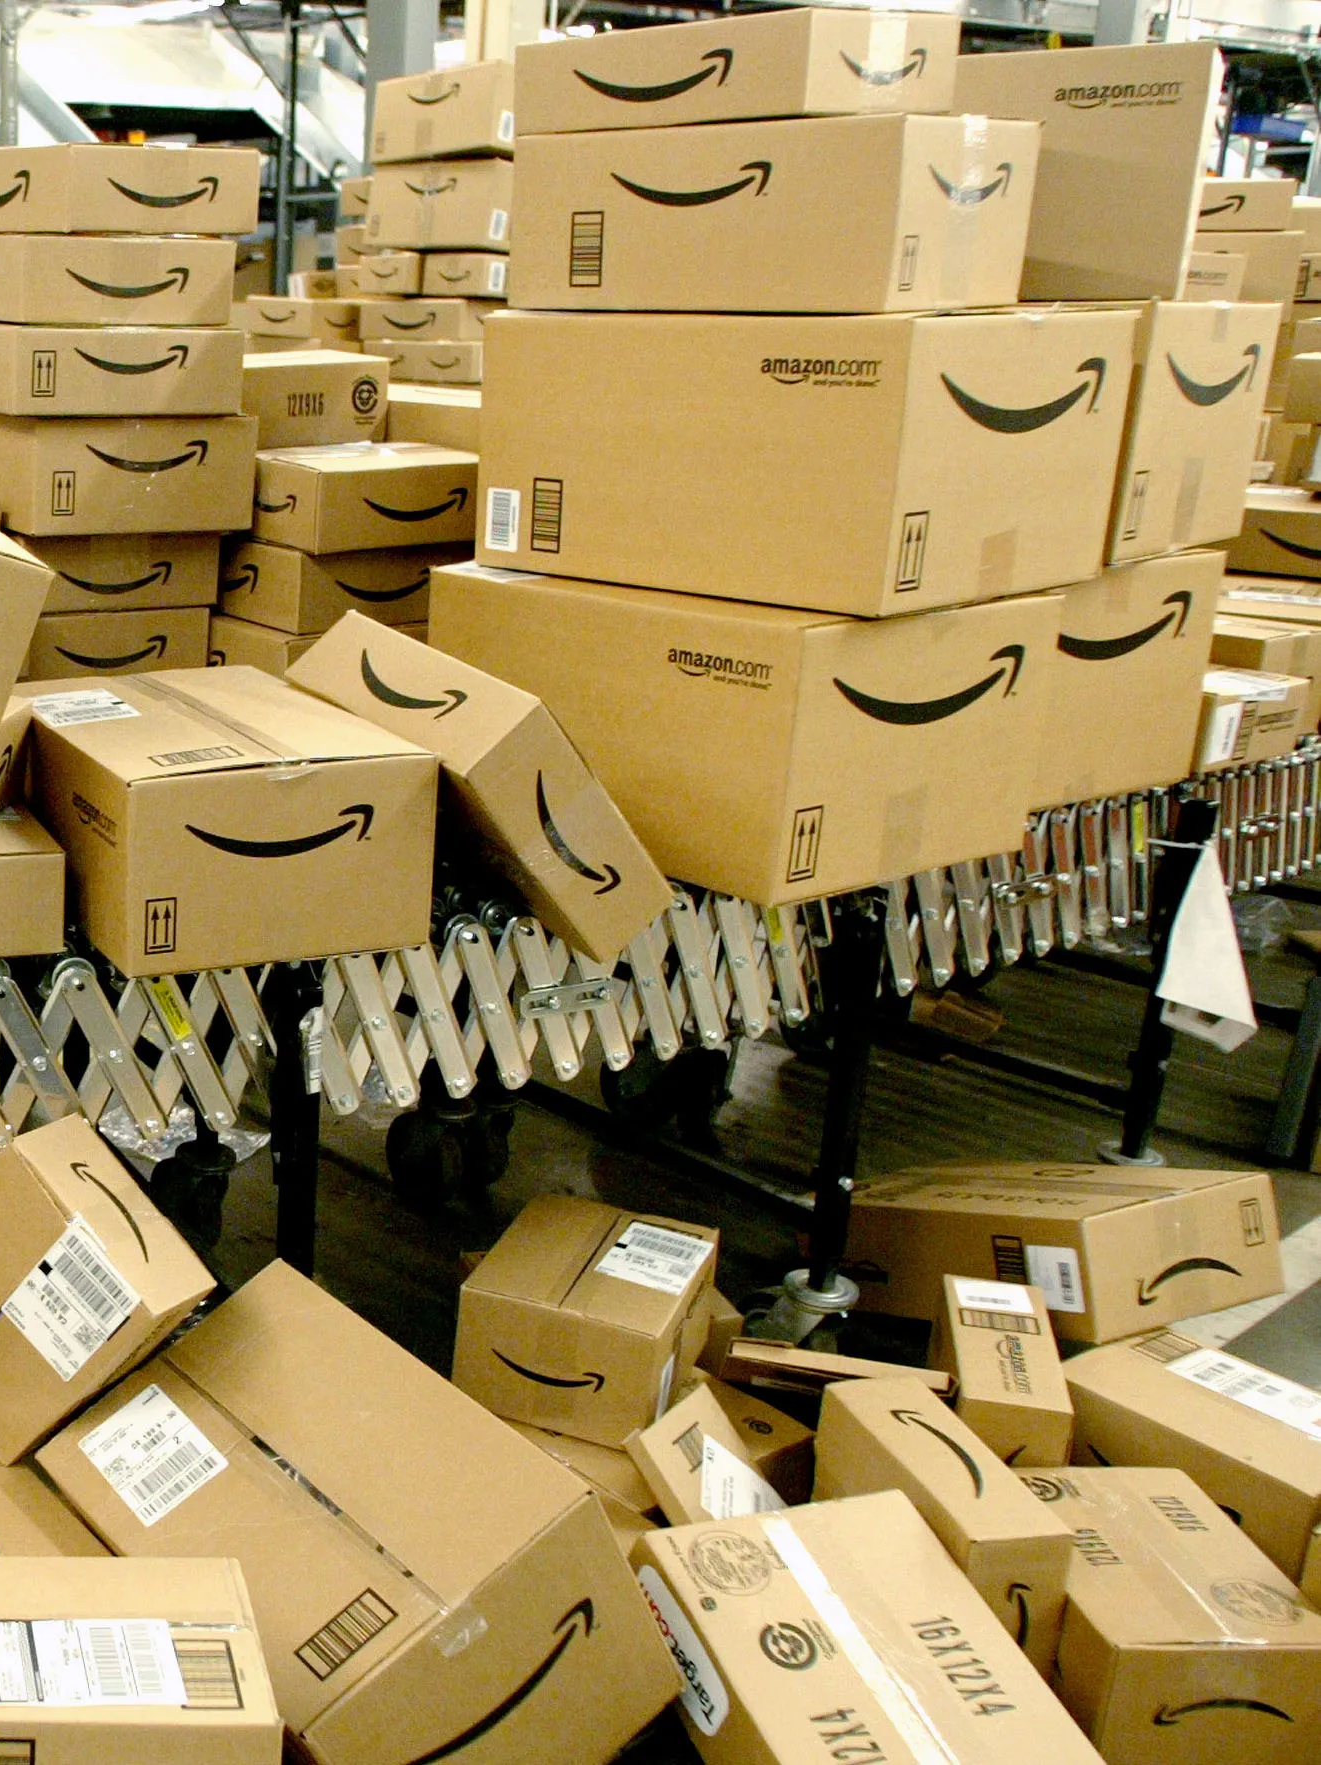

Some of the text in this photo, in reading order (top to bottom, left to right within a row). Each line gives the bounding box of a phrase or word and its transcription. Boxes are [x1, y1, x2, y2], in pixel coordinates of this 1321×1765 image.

[1054, 81, 1183, 102] amazon.com
[760, 357, 882, 377] amazon.com
[287, 391, 324, 417] 12X9X6
[667, 647, 772, 680] amazon.com
[910, 1615, 1017, 1717] 16X12X4
